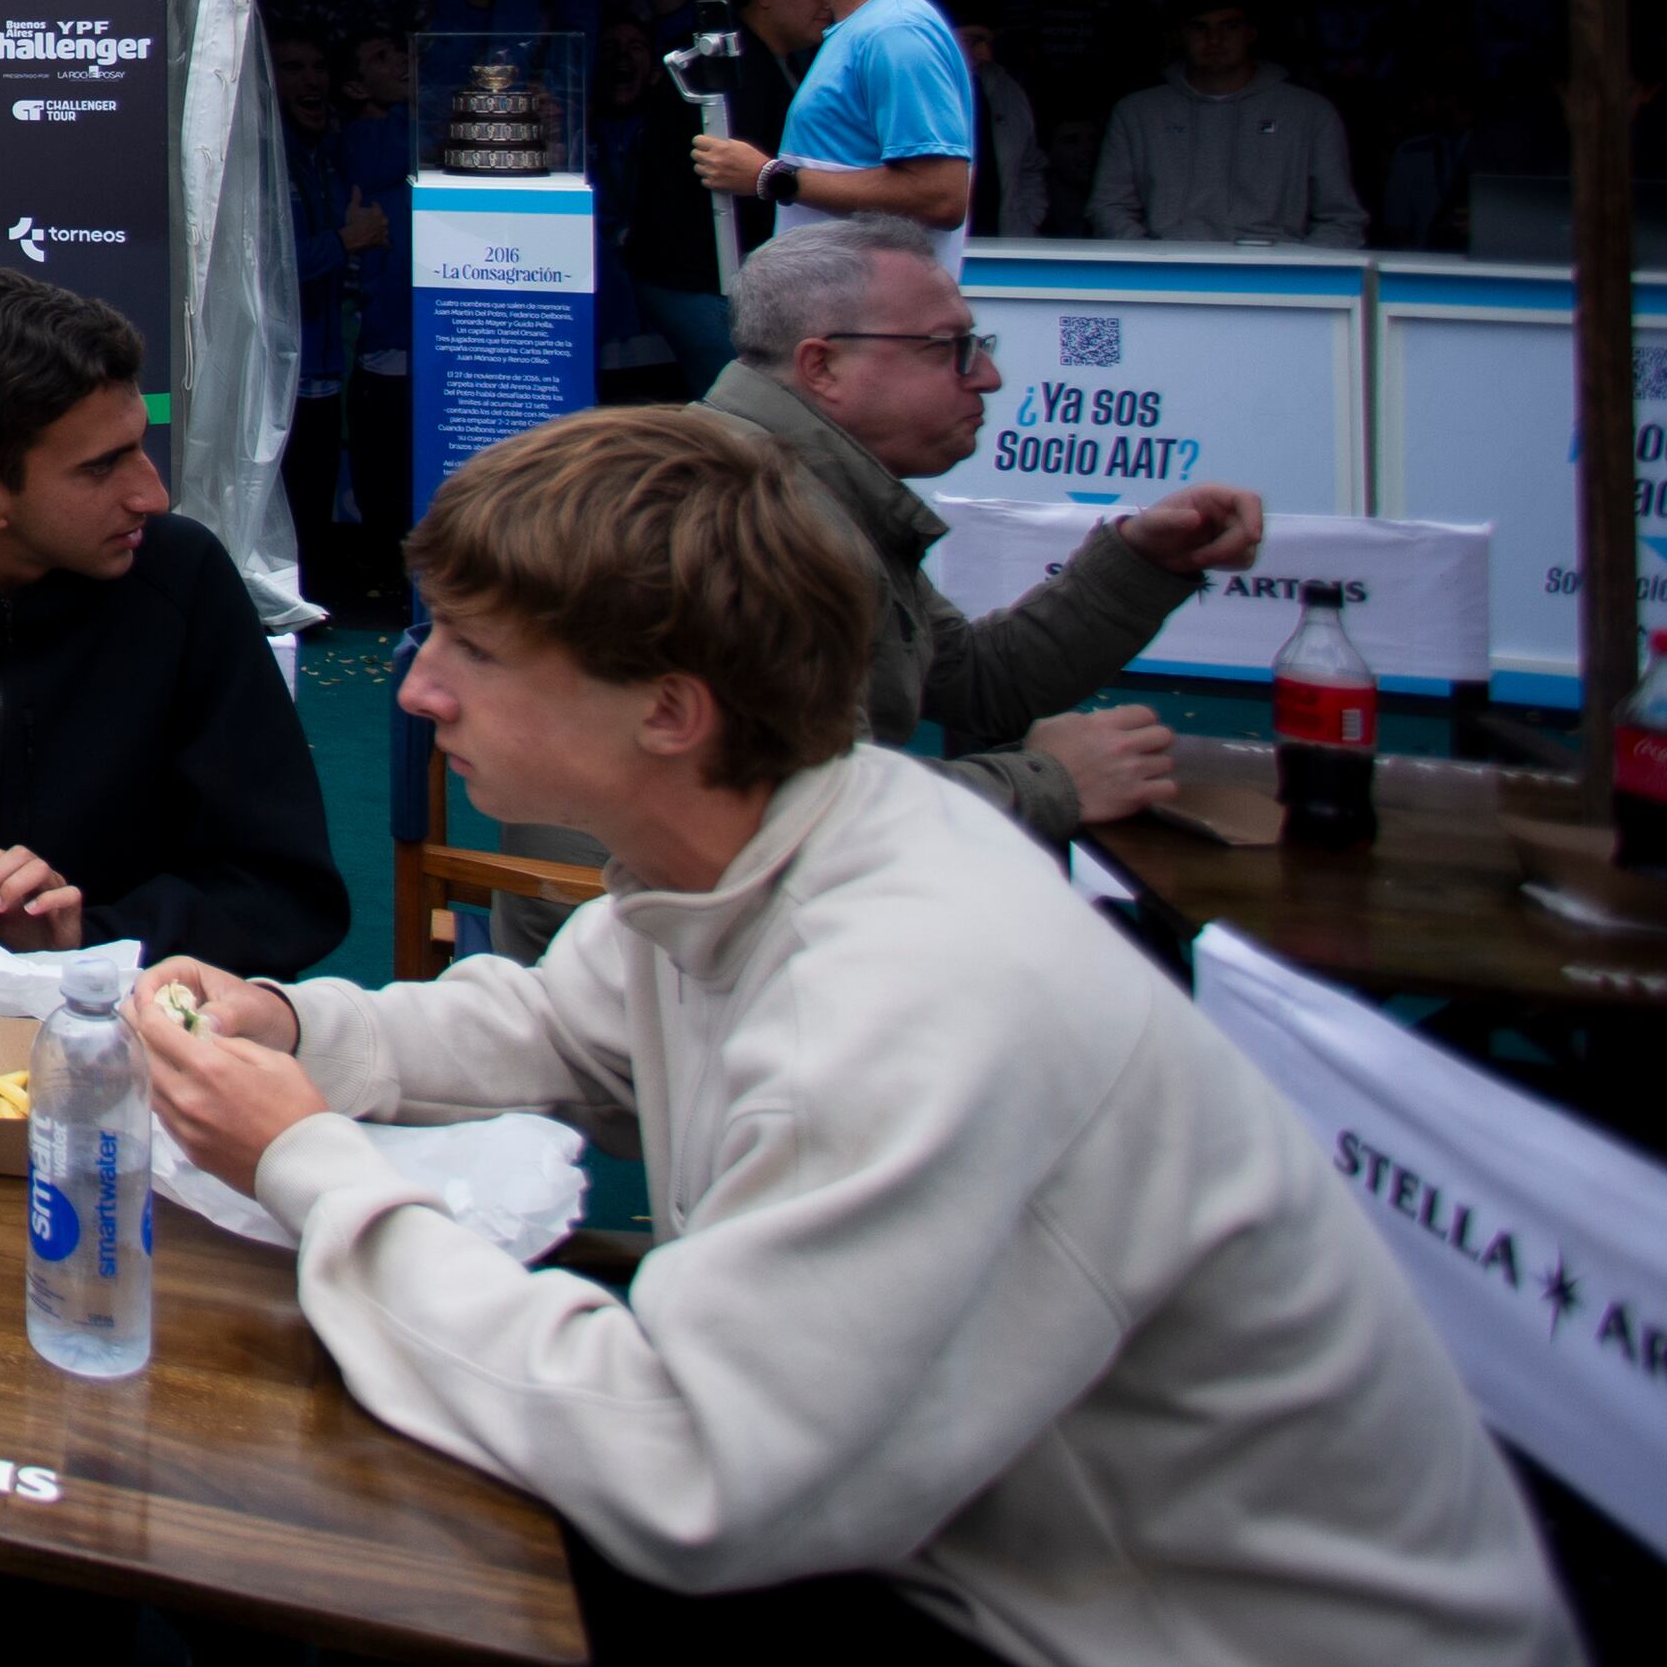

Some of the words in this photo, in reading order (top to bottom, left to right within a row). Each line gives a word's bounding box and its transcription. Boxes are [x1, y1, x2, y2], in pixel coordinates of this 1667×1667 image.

[6, 21, 46, 30] Buenos
[6, 29, 33, 38] Aires
[57, 21, 109, 35] YPF
[46, 101, 116, 111] CHALLENGER
[46, 111, 76, 121] TOUR
[48, 226, 126, 243] torneos
[484, 246, 520, 263] 2016
[1016, 380, 1083, 428] ¿Ya
[1091, 388, 1161, 428] sos
[994, 431, 1098, 476] Socio
[1107, 437, 1200, 481] AAT?
[53, 1122, 67, 1178] water
[30, 1108, 52, 1240] smart
[97, 1131, 118, 1279] smartwater
[1335, 1130, 1519, 1289] STELLA
